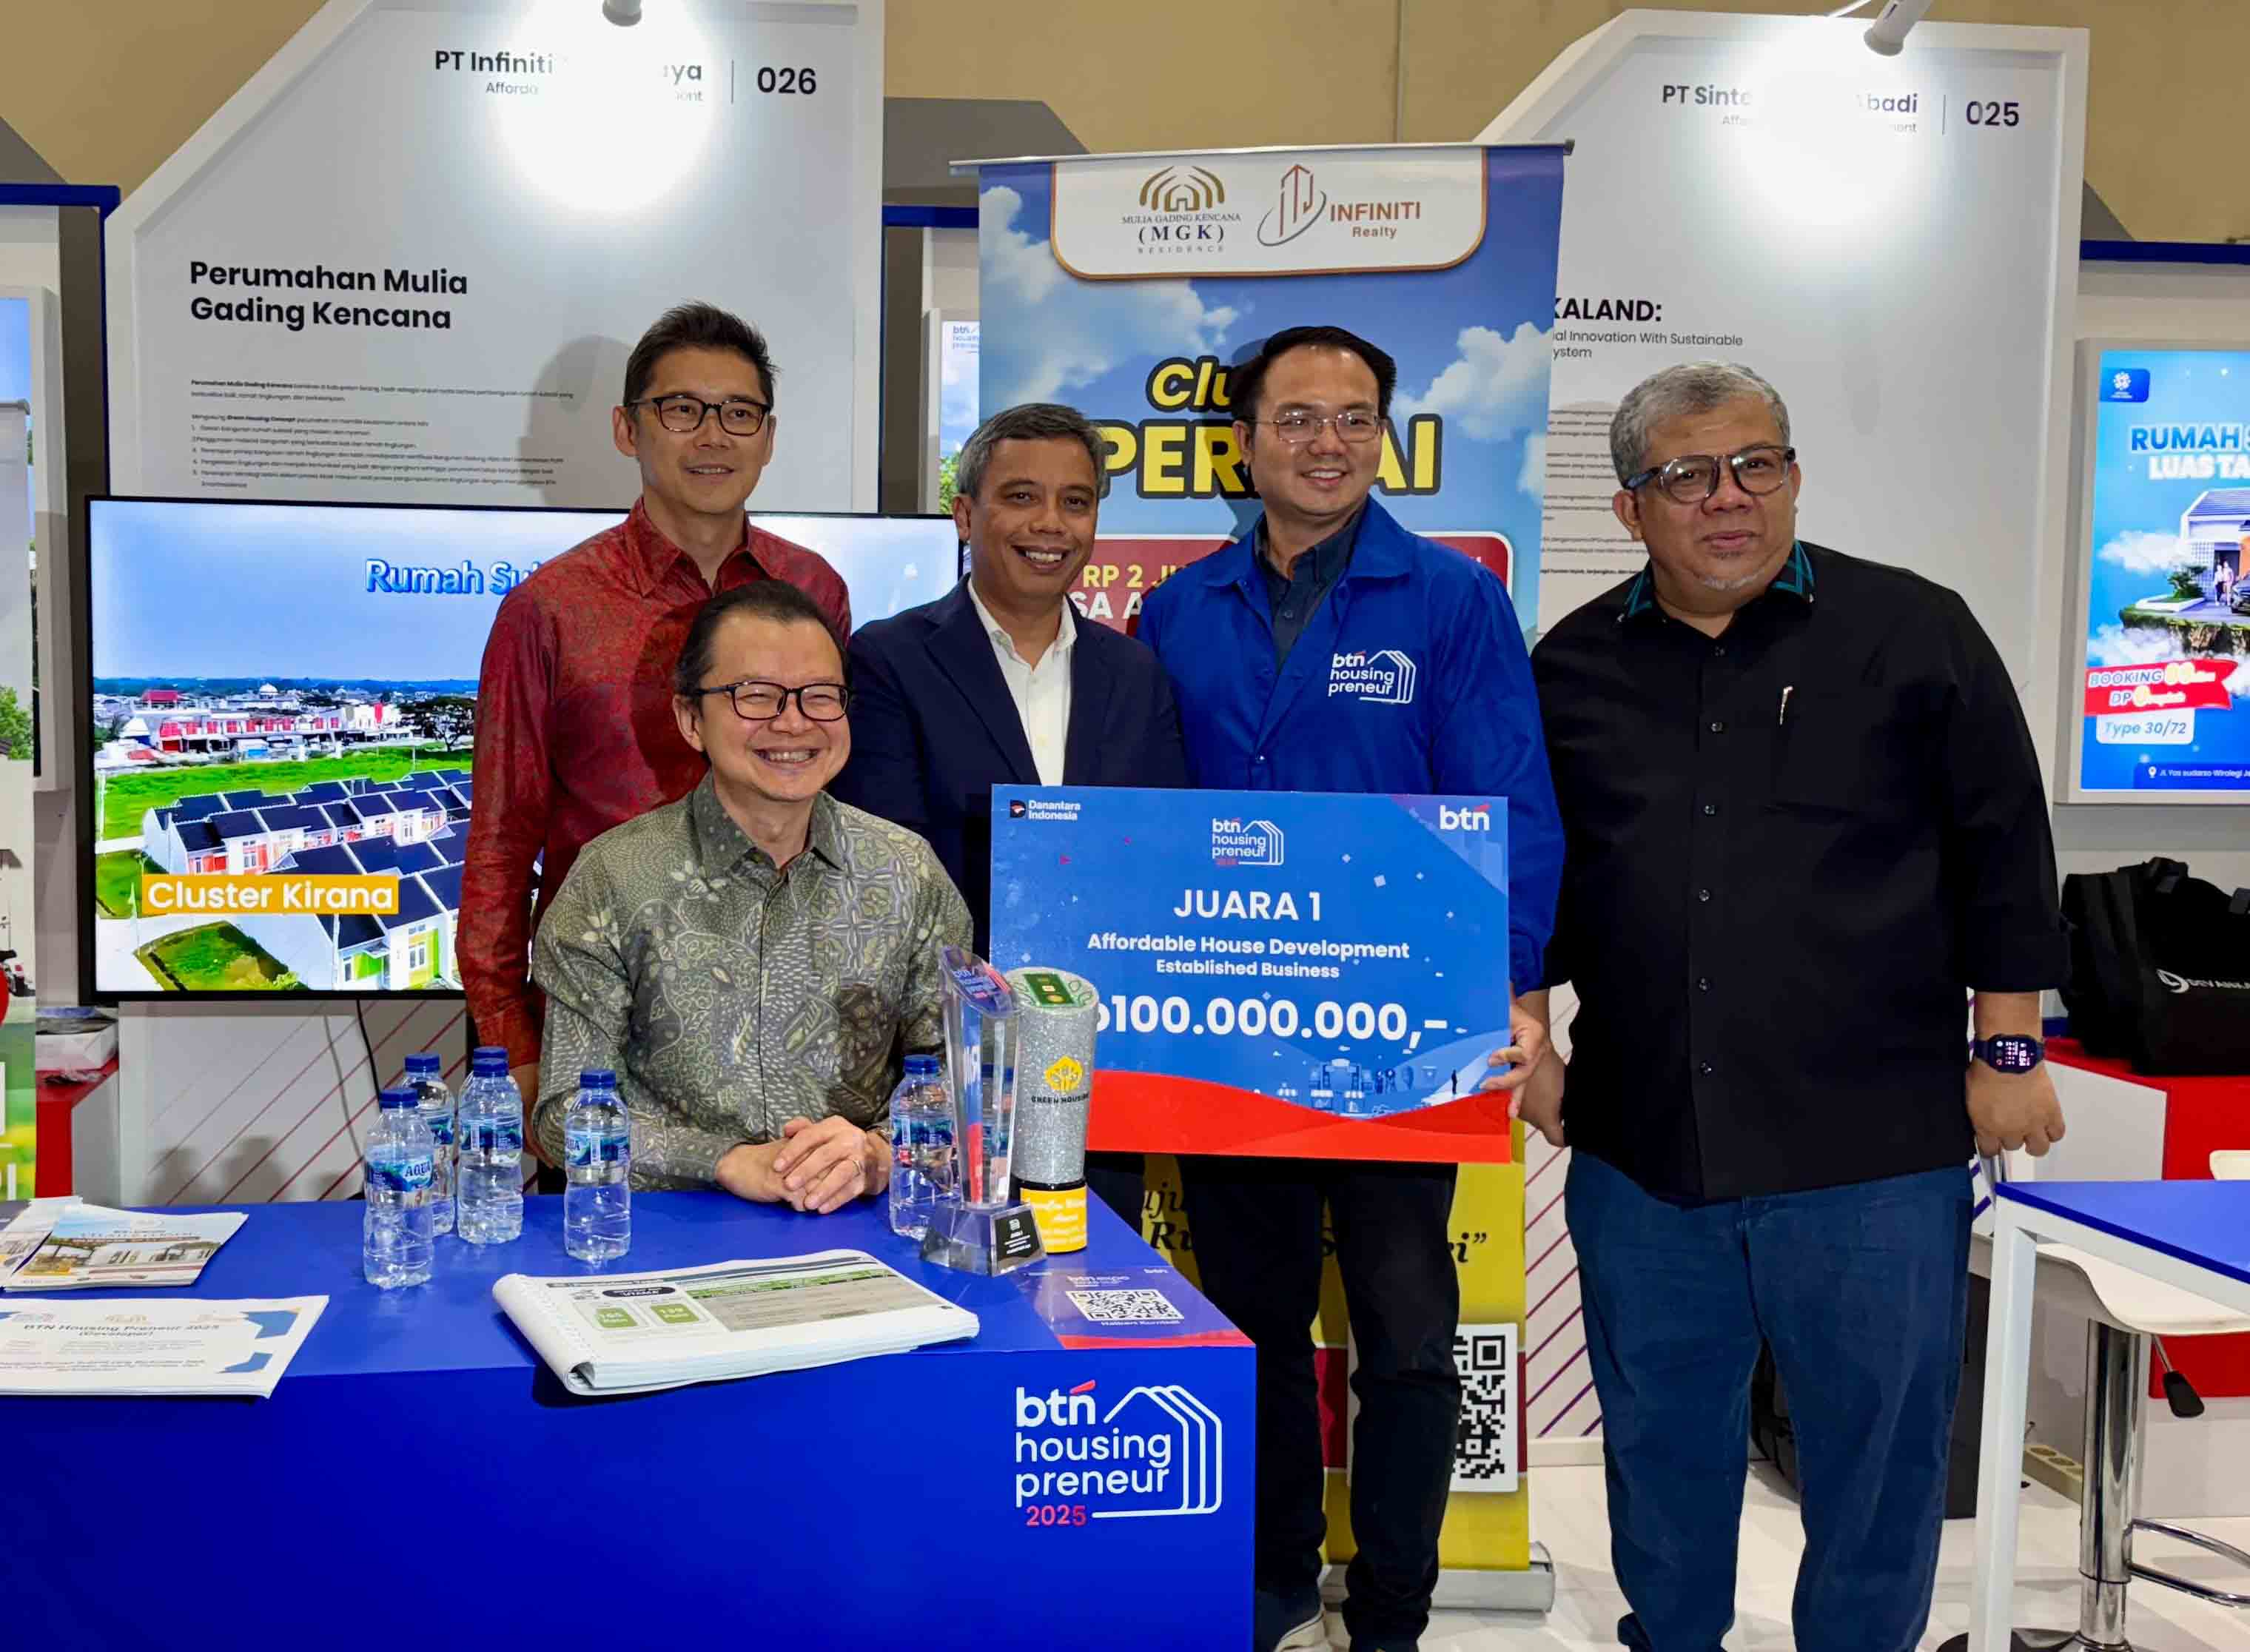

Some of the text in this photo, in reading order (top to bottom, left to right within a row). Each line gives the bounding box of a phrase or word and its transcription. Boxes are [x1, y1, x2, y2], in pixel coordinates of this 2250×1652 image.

[435, 50, 465, 71] PT
[471, 52, 553, 73] Infiniti
[756, 67, 816, 95] 026
[1662, 85, 1690, 104] PT
[1966, 101, 2020, 127] 025
[1331, 201, 1421, 222] INFINITI
[1352, 226, 1397, 239] Realty
[189, 261, 468, 295] Perumahan Mulia
[190, 296, 451, 332] Gading Kencana
[1570, 331, 1636, 343] Innovation
[1639, 332, 1667, 344] With
[1670, 333, 1743, 346] Sustainable
[1553, 346, 1592, 360] ystem
[1149, 360, 1232, 409] Clu
[2131, 426, 2240, 451] RUMAH
[1099, 418, 1437, 494] PERAI
[366, 558, 485, 594] Rumah
[1083, 564, 1120, 588] RP
[1126, 564, 1144, 588] 2
[1069, 591, 1113, 620] SA
[1332, 651, 1366, 668] btn
[1330, 667, 1395, 685] housing
[2089, 671, 2163, 688] BOOKING
[1328, 682, 1394, 697] preneur
[2109, 690, 2132, 706] DP
[2105, 718, 2187, 739] Type 30/72
[1028, 799, 1081, 810] Danantara
[1028, 810, 1078, 821] Indonesia
[1212, 817, 1241, 833] btn
[1440, 804, 1491, 831] btn
[1212, 833, 1266, 847] housing
[1212, 846, 1266, 859] preneur
[147, 881, 393, 910] Cluster Kirana
[1174, 890, 1322, 921] JUARA 1
[1087, 933, 1410, 961] Affordable House Development
[1156, 959, 1340, 978] Established Business
[1096, 995, 1448, 1050] 100.000.000,-
[1016, 1380, 1096, 1427] btn
[1016, 1428, 1171, 1468] housing
[1015, 1468, 1170, 1508] preneur
[1025, 1505, 1087, 1527] 2025
